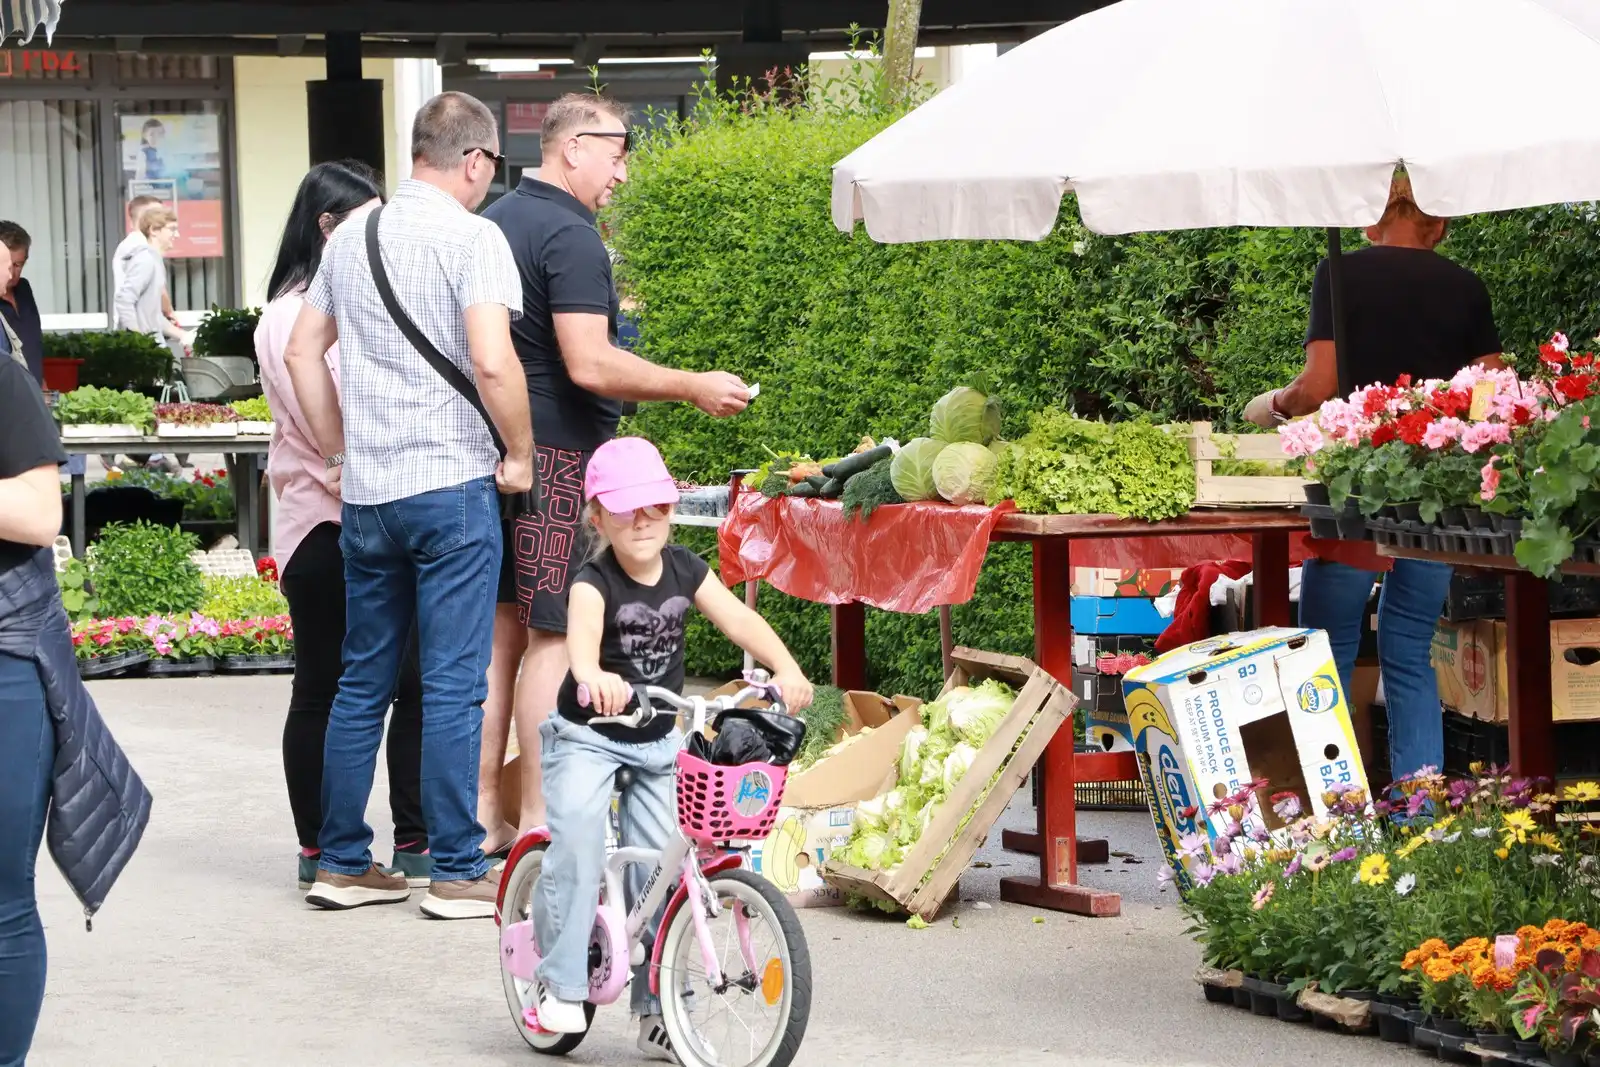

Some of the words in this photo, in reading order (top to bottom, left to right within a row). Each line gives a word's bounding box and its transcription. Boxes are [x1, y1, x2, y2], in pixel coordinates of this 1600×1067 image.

[538, 449, 583, 594] NDER
[1238, 663, 1257, 679] CB
[1184, 697, 1194, 717] KEEP
[1188, 717, 1196, 726] AT
[1193, 695, 1211, 742] VACUUM
[1205, 744, 1218, 774] PACK
[1207, 689, 1231, 755] PRODUCE
[1224, 757, 1237, 776] OF
[1196, 744, 1204, 756] OR
[1137, 752, 1162, 824] PREMIUM
[1155, 774, 1172, 818] QUALITY
[813, 888, 840, 900] PACK
